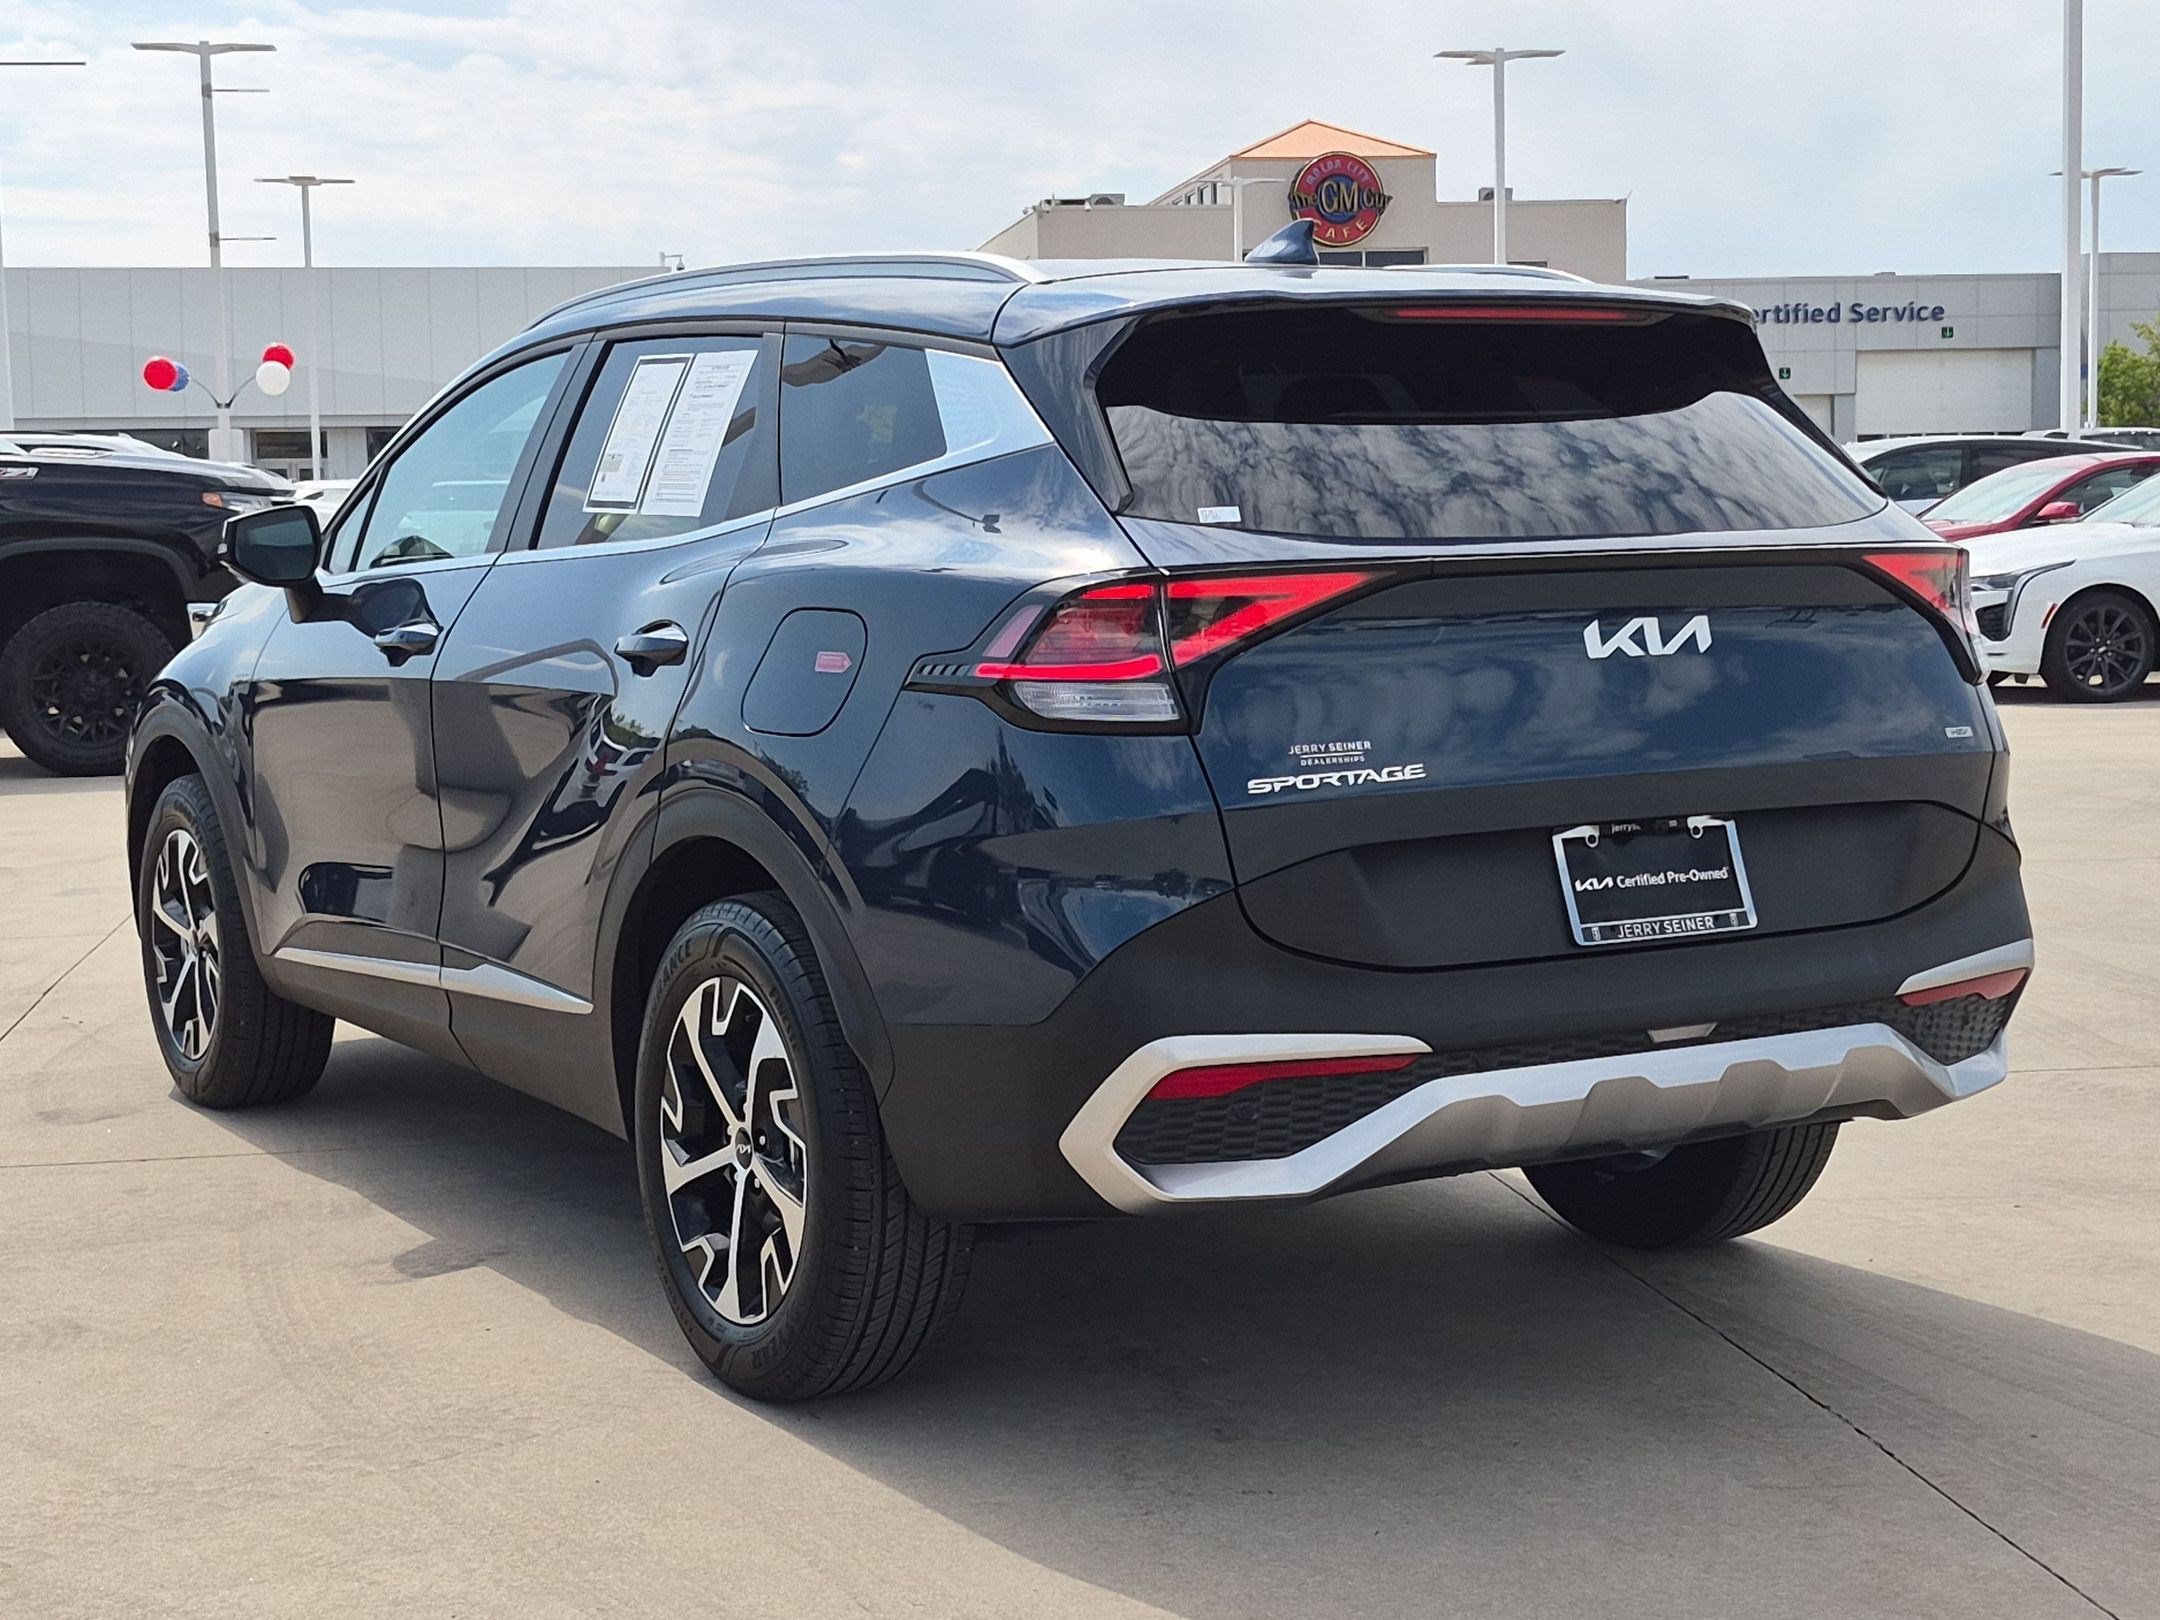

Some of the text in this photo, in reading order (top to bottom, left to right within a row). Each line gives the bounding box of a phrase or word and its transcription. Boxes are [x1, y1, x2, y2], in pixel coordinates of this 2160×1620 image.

[1321, 180, 1359, 213] GM
[1850, 301, 1946, 324] Service
[1288, 740, 1372, 755] JERRY SEINER
[1247, 763, 1427, 794] SPORTAGE
[1617, 872, 1666, 889] Certified
[1667, 868, 1728, 885] Pre-Owned
[1617, 922, 1660, 938] JERRY
[1664, 916, 1715, 934] SEINER
